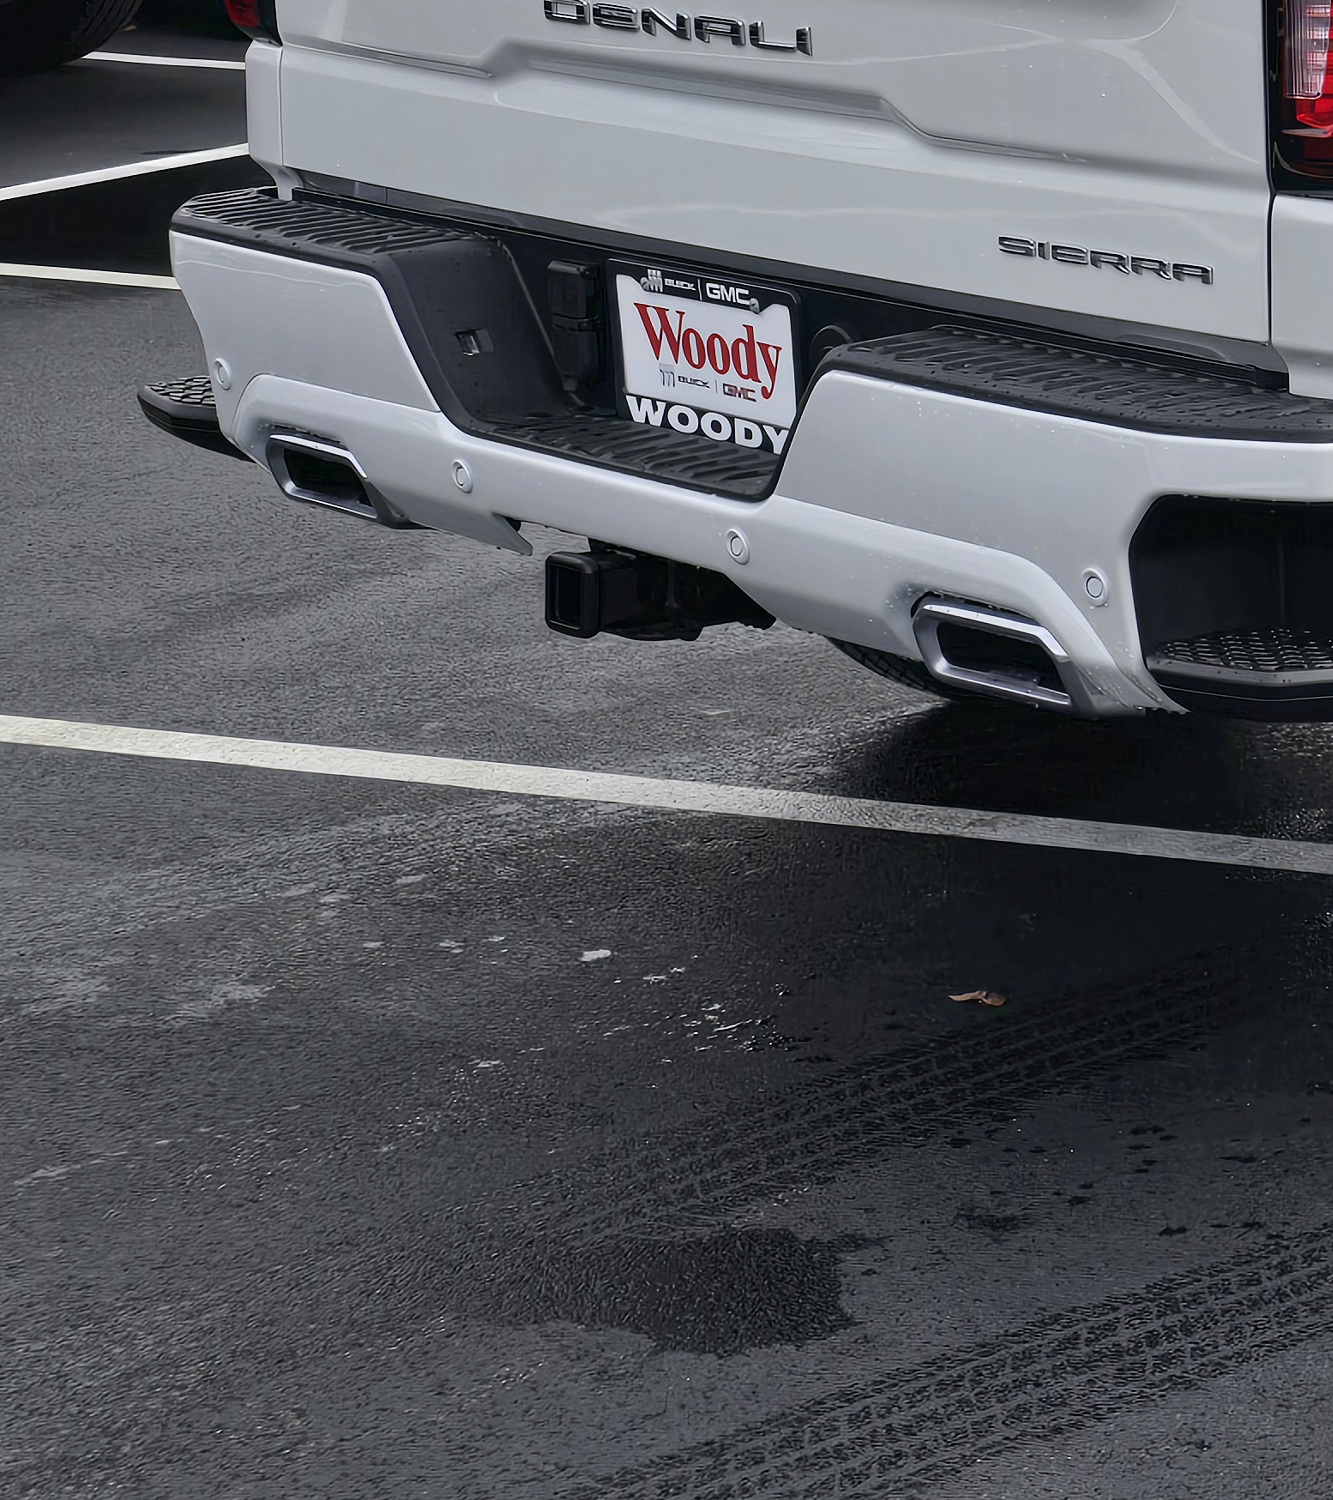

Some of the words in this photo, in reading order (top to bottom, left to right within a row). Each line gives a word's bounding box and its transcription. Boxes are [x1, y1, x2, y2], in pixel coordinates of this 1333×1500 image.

[998, 235, 1214, 285] SIERRA
[705, 282, 750, 305] GMC
[633, 302, 783, 400] Woody
[722, 383, 758, 403] GMC
[625, 394, 790, 455] WOODY
